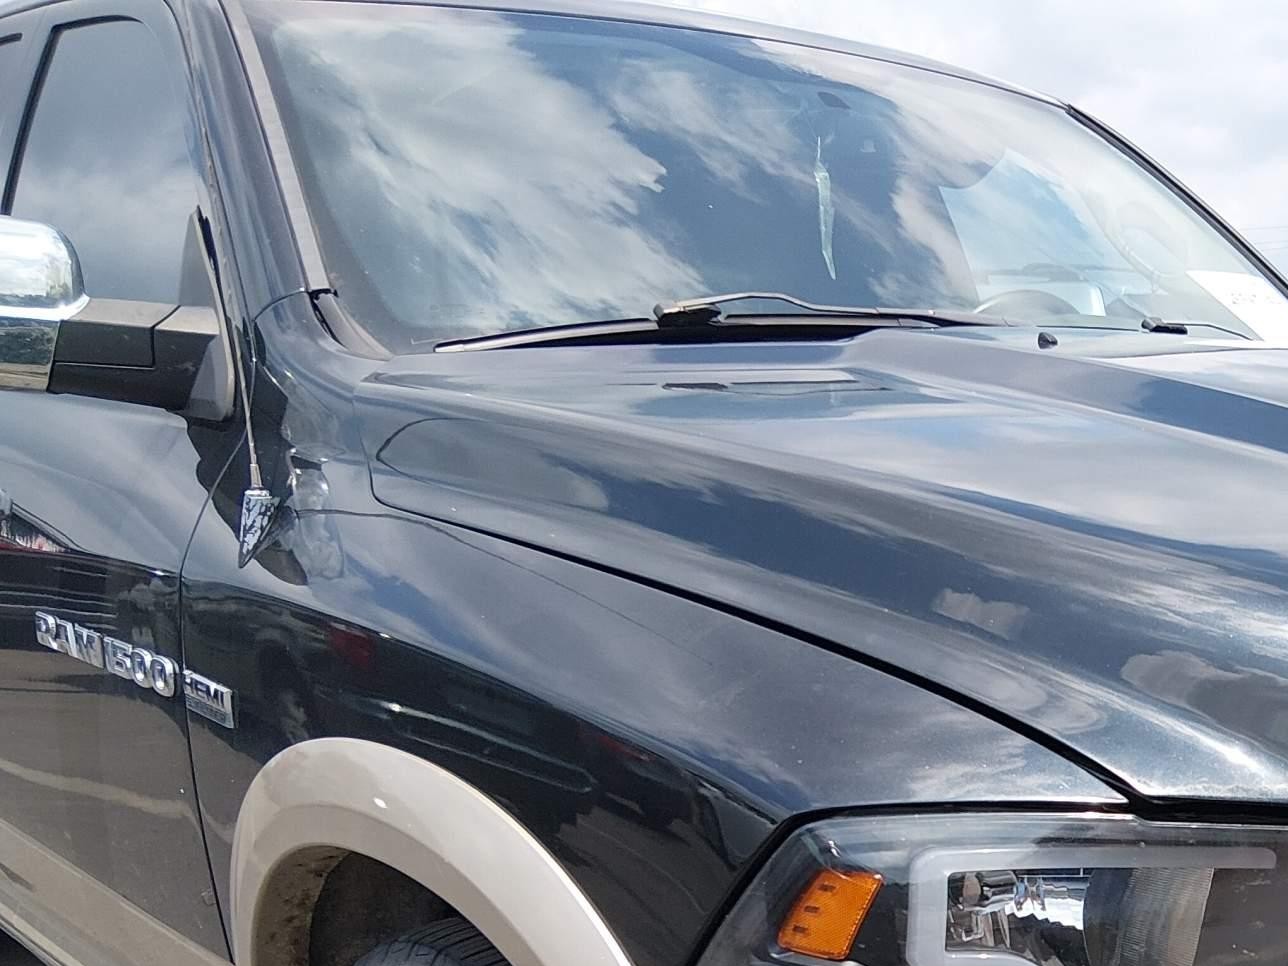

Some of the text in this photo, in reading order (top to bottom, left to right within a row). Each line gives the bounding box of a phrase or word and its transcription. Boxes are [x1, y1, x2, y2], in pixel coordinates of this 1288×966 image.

[35, 611, 177, 697] RAM 1500
[184, 672, 227, 709] HEMI
